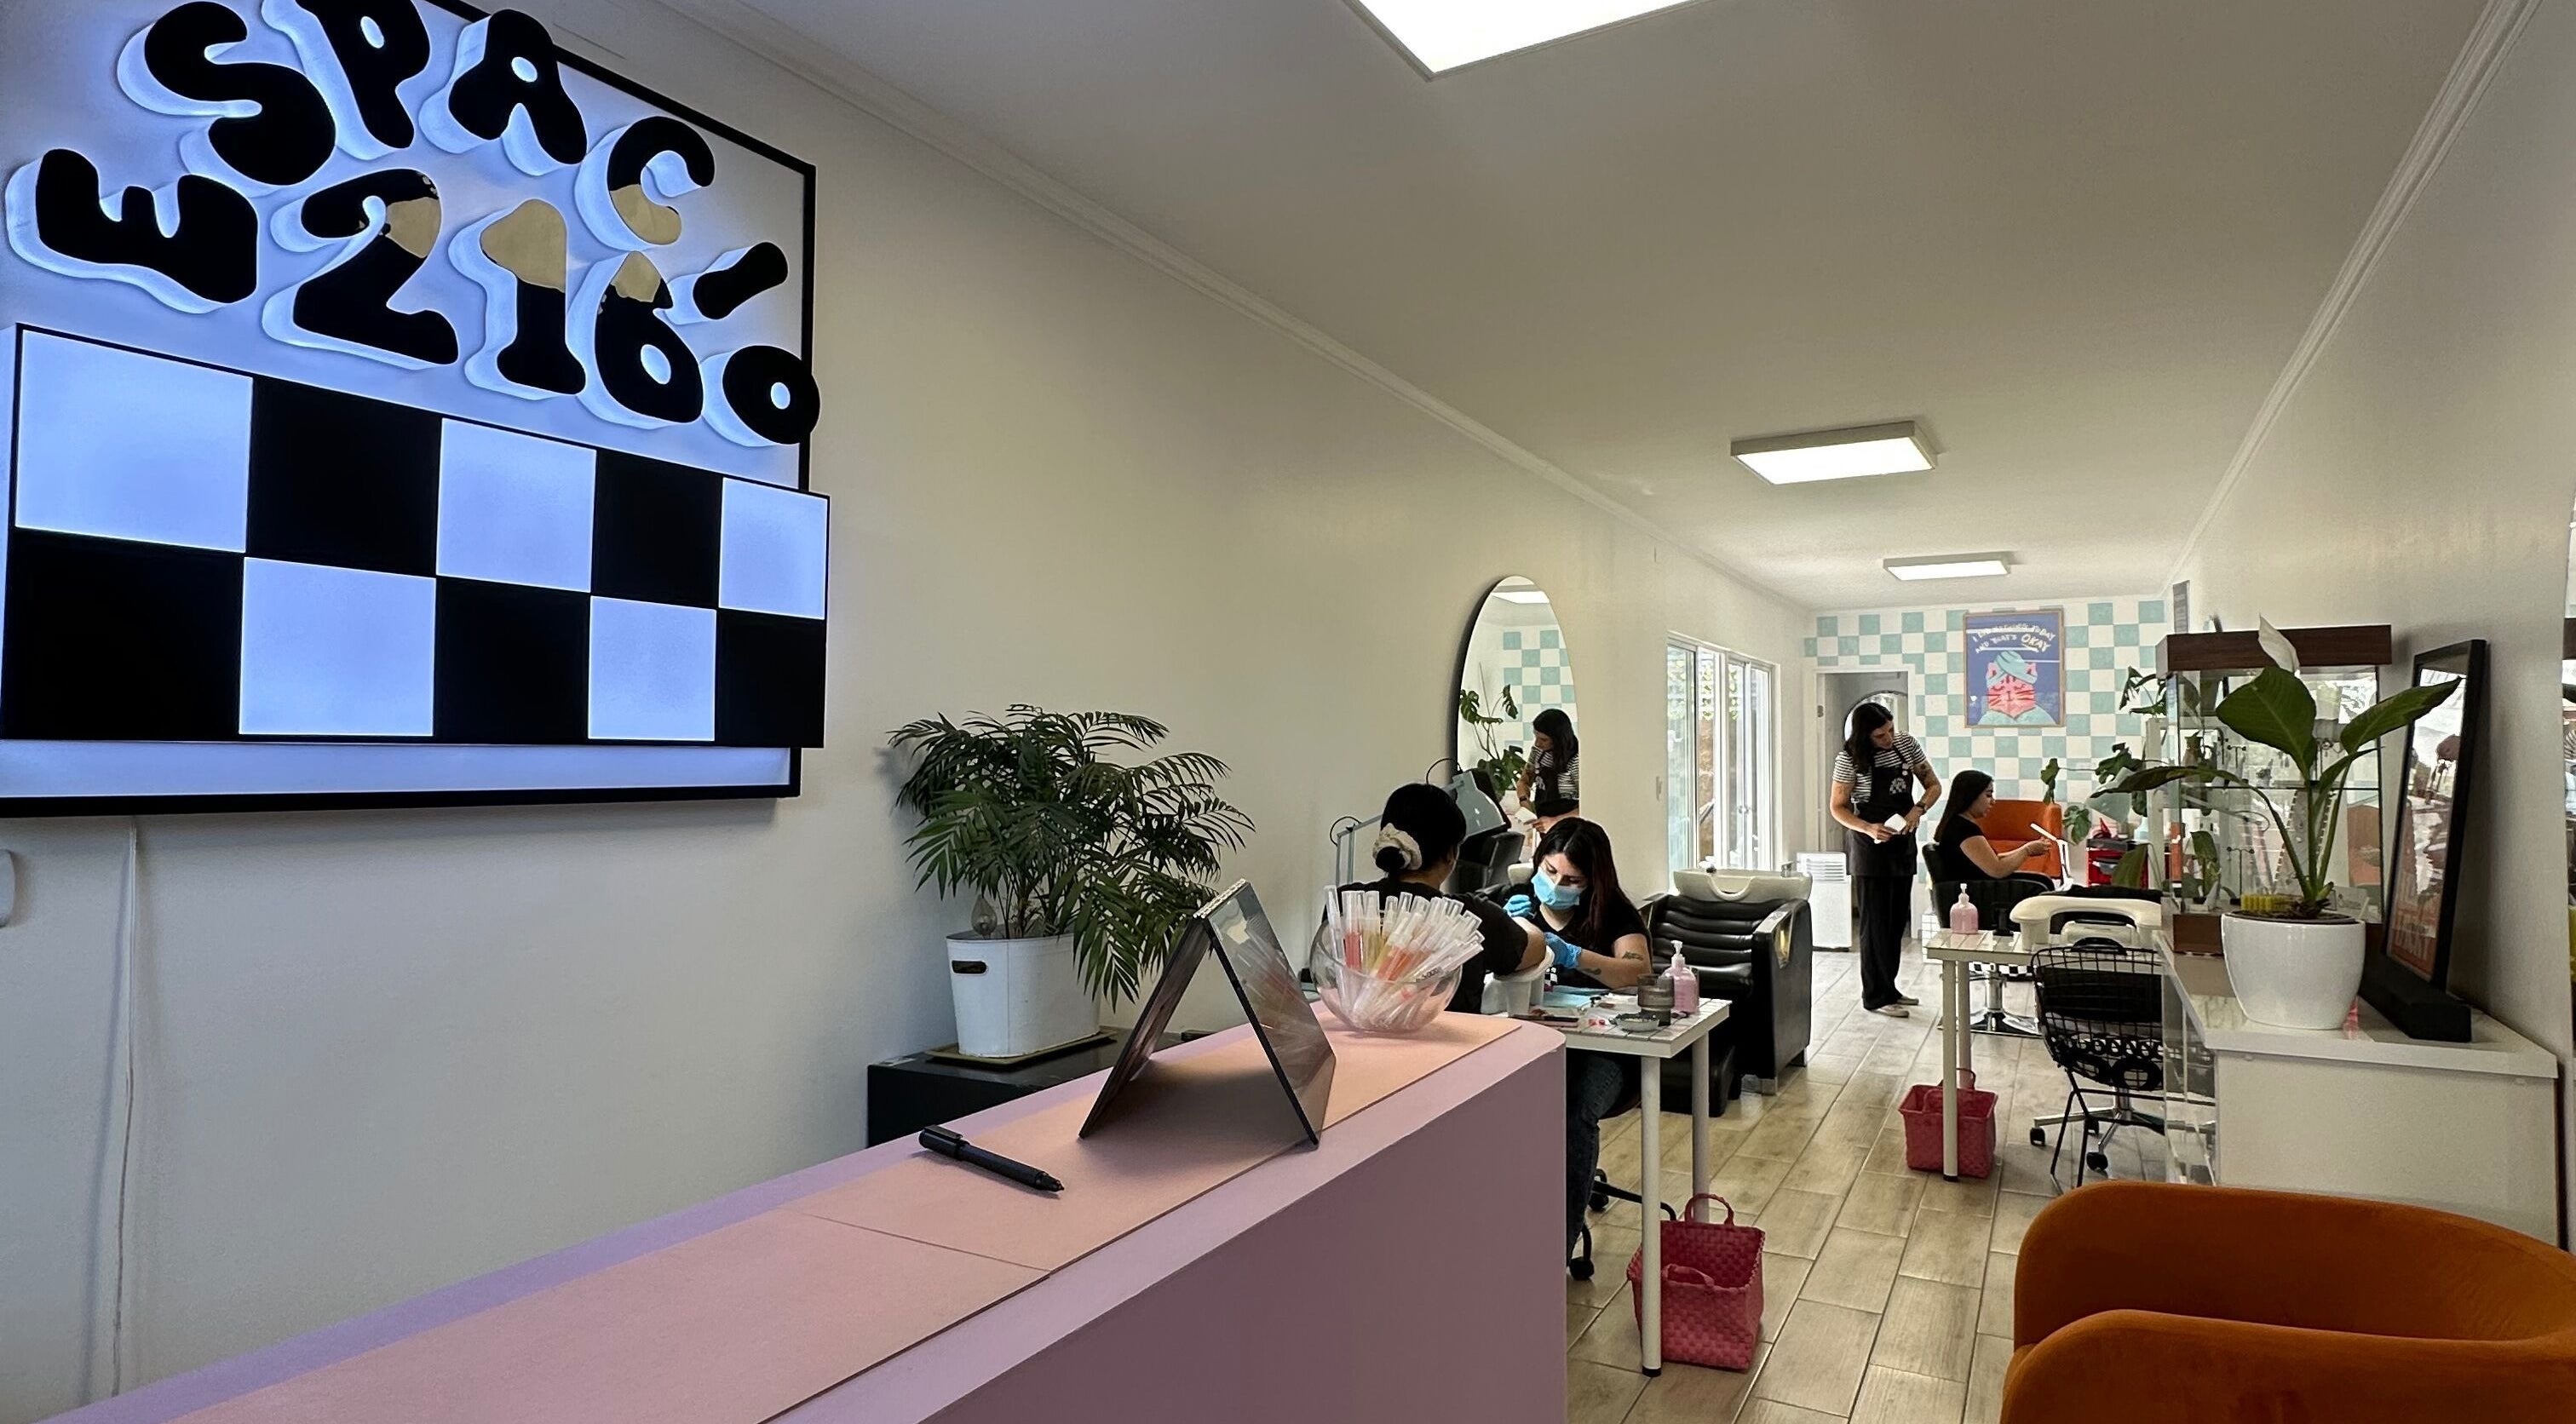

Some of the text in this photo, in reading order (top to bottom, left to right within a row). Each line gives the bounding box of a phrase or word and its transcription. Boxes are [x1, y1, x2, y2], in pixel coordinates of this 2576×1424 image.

[35, 0, 821, 445] ESPACIO
[293, 168, 704, 424] 216
[1975, 640, 1989, 654] AND
[2021, 633, 2051, 652] OKAY
